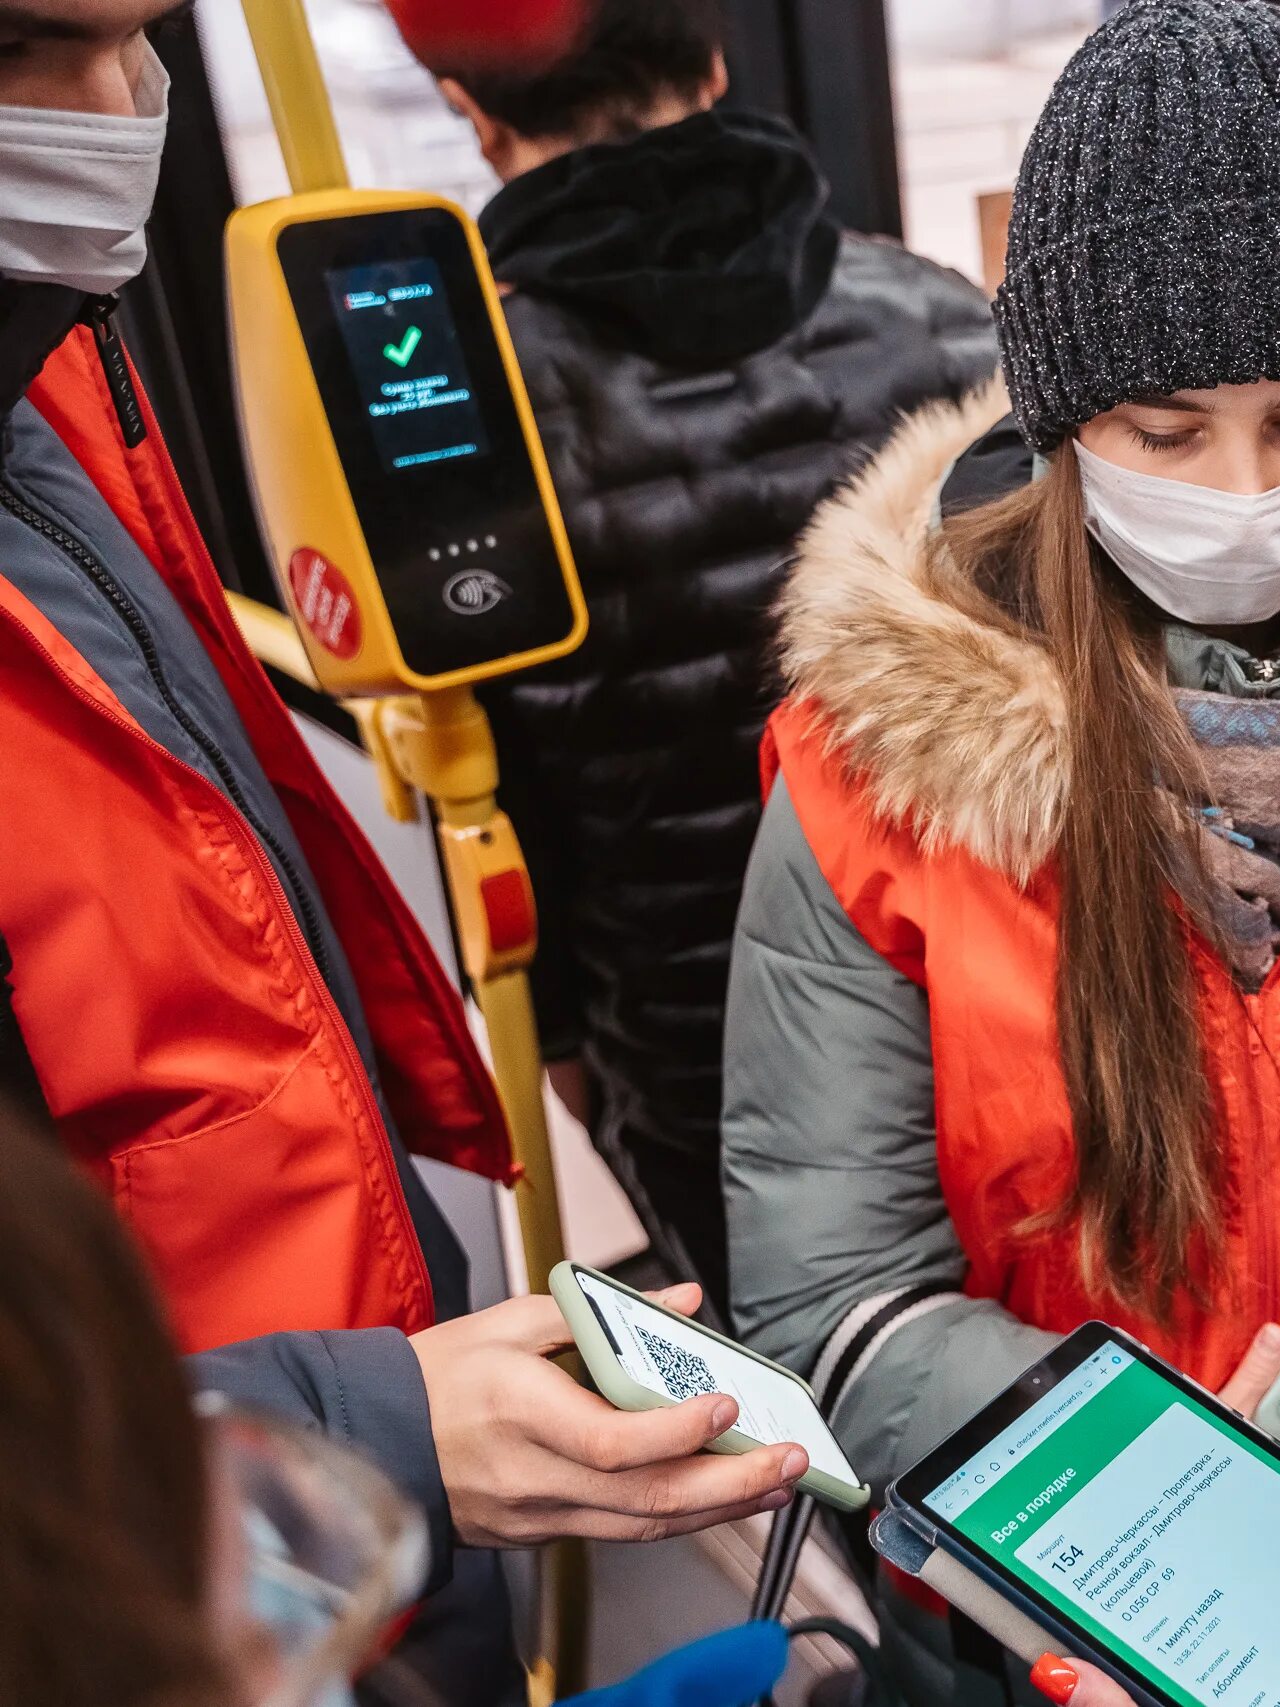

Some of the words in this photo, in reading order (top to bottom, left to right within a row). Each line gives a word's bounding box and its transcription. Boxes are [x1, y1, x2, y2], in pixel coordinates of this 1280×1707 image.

[991, 1521, 1018, 1544] Все
[1016, 1512, 1028, 1523] в
[1026, 1468, 1076, 1513] порядке
[1073, 1506, 1159, 1591] Дмитрово-Черкассы
[1163, 1455, 1211, 1499] Пролетарка
[1086, 1567, 1121, 1600] Речной
[1119, 1538, 1150, 1569] вокзал
[1152, 1457, 1232, 1537] Дмитрово-Черкассы
[1037, 1535, 1064, 1560] Маршрут
[1052, 1545, 1084, 1573] 154
[1101, 1559, 1155, 1611] (кольцевой)
[1130, 1596, 1149, 1613] 056
[1146, 1582, 1159, 1596] СР
[1162, 1568, 1174, 1580] 69
[1143, 1617, 1168, 1642] Оплачен
[1166, 1615, 1198, 1648] минуту
[1195, 1589, 1223, 1616] назад
[1190, 1617, 1221, 1649] 22.11.2021
[1196, 1672, 1207, 1683] Тип
[1208, 1649, 1230, 1672] оплаты
[1213, 1646, 1258, 1698] Абонемент
